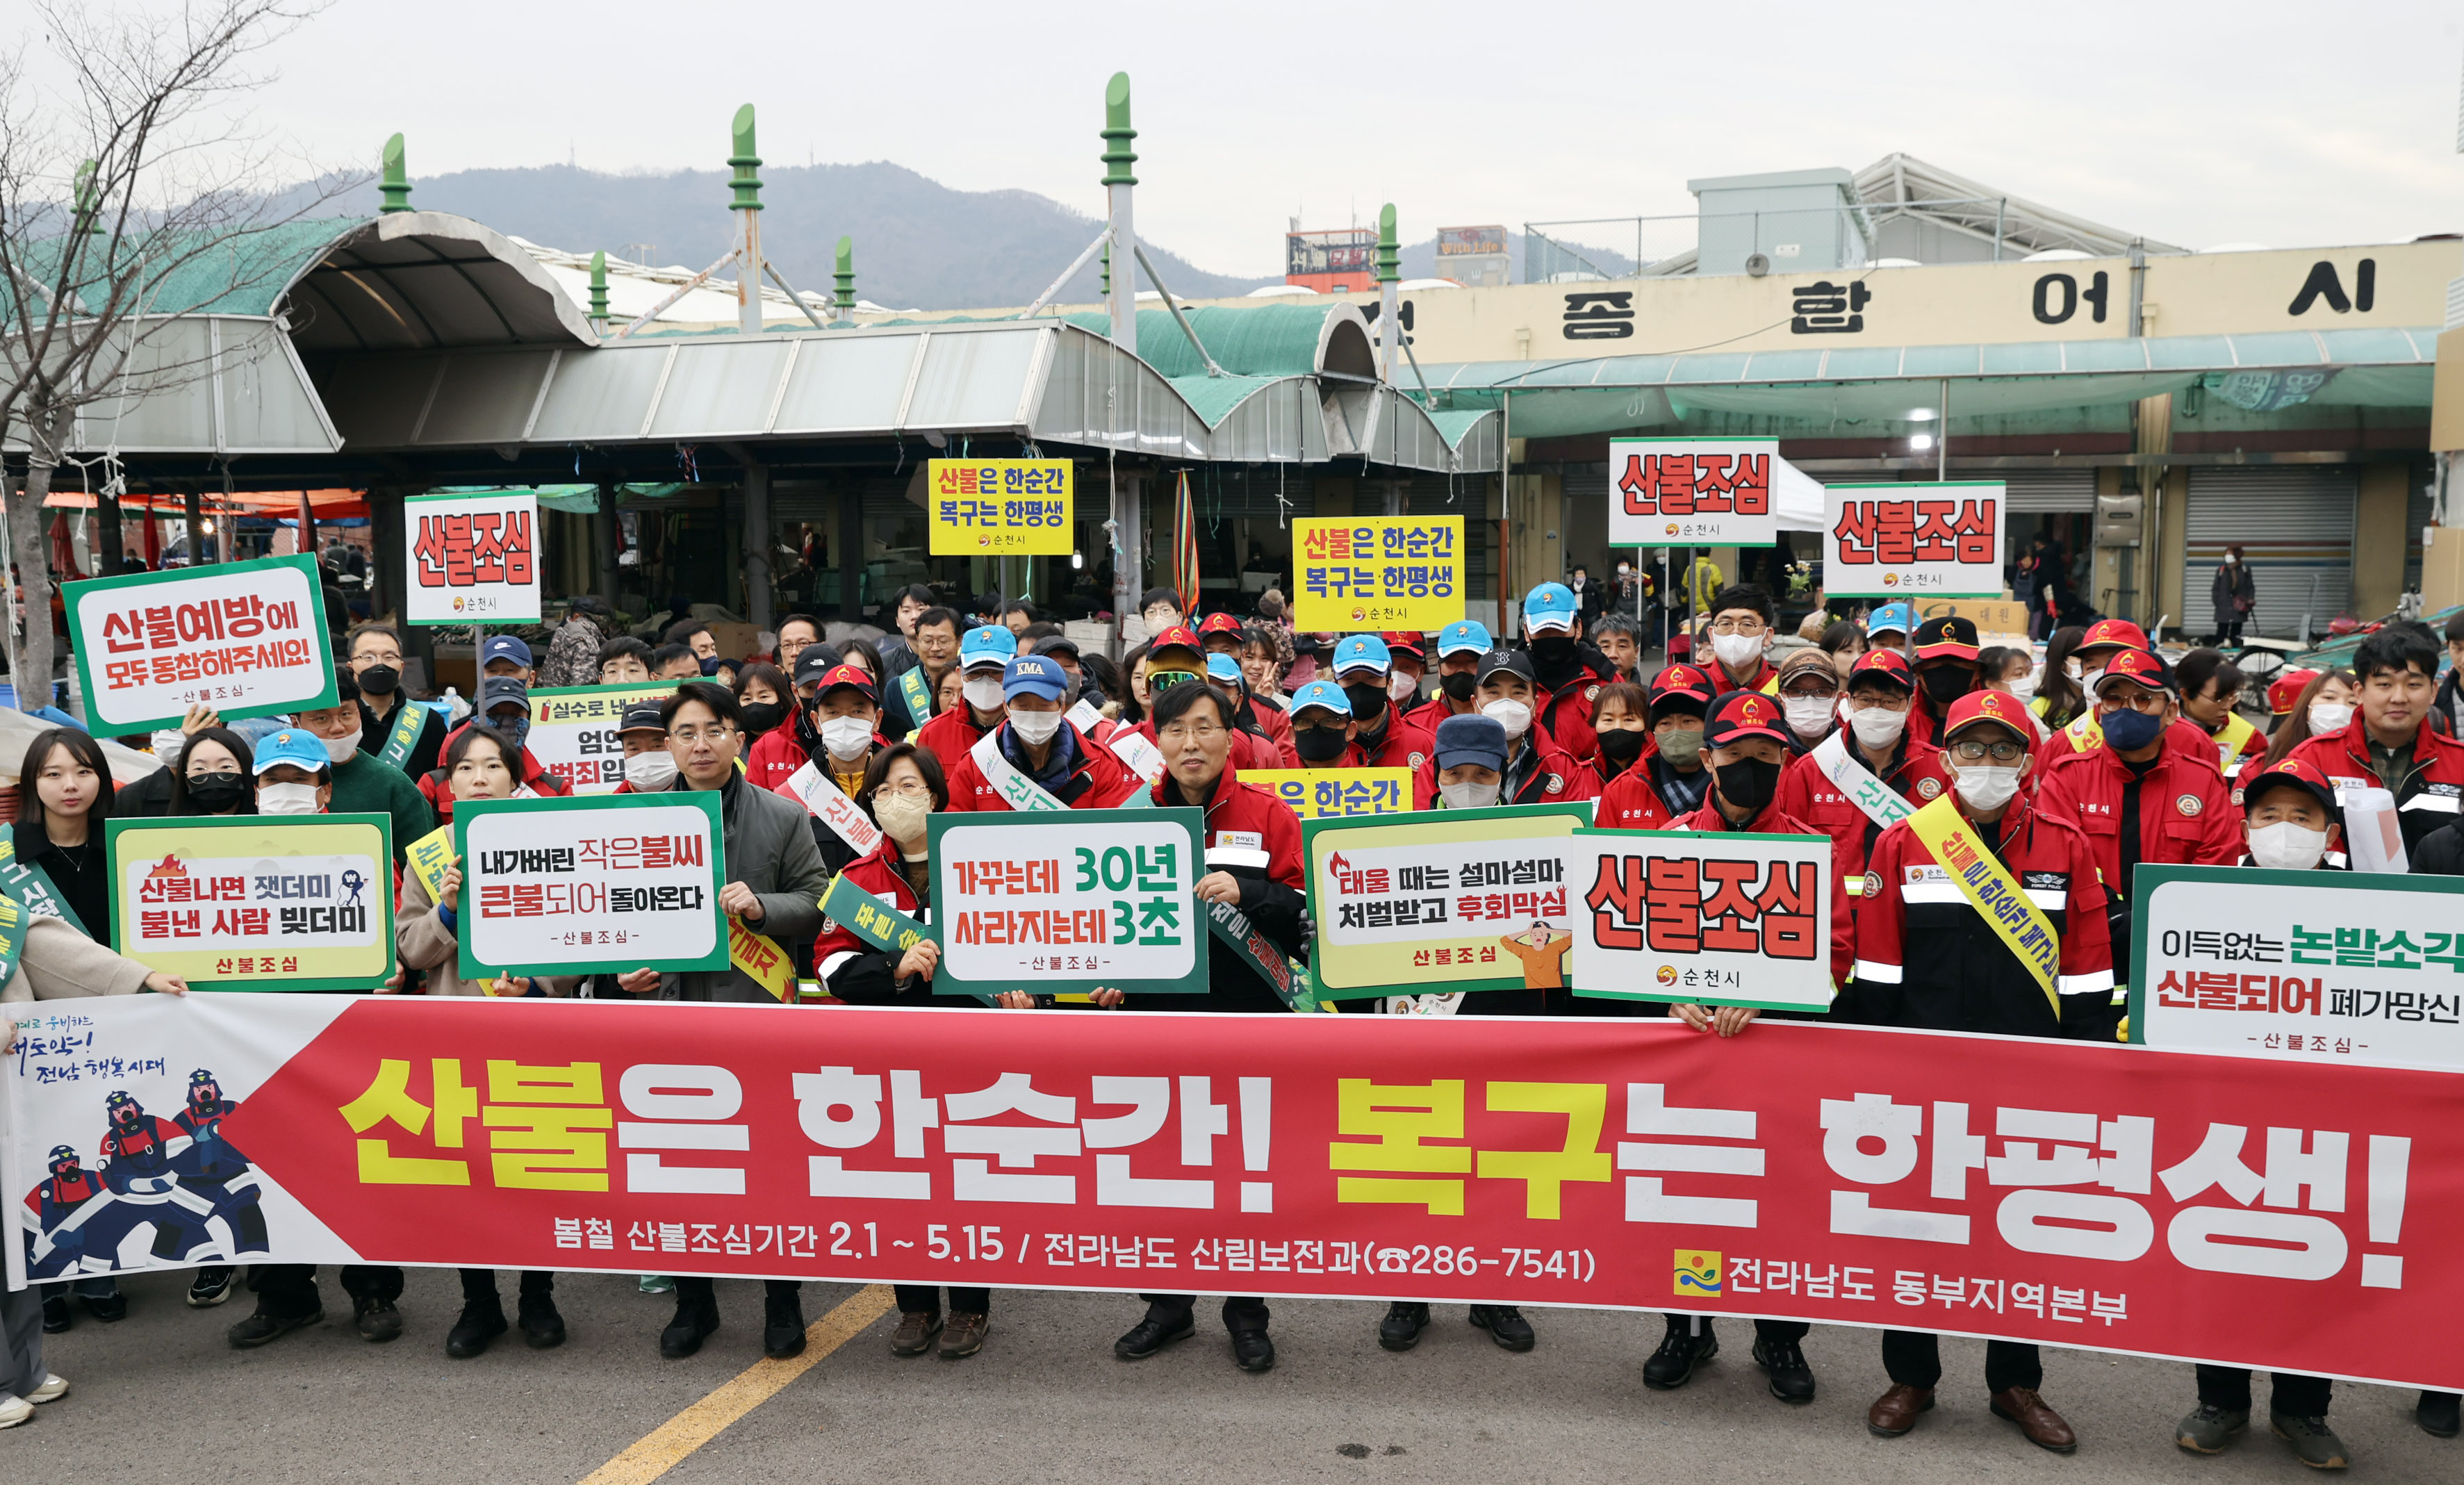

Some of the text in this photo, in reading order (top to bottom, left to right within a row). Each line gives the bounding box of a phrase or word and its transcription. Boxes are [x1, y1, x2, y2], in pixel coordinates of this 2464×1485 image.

[938, 468, 1065, 495] 산불은 한순간
[1618, 453, 1769, 516] 산불조심
[939, 499, 1065, 528] 복구는 한평생
[1683, 523, 1720, 536] 순천시
[993, 534, 1026, 545] 순천시
[1304, 527, 1454, 559] 산불은 한순간
[1834, 498, 1996, 565] 산불조심
[413, 510, 532, 587] 산불조심
[1305, 565, 1453, 598] 복구는 한평생
[1902, 573, 1942, 587] 순천시
[467, 598, 497, 612] 순천시
[1369, 607, 1408, 620] 순천시
[103, 594, 299, 654] 산불예방에
[106, 638, 311, 690] 모두 동참해주세요!
[1017, 662, 1045, 676] KMA
[552, 700, 604, 719] 실수로
[767, 762, 795, 771] 순천시
[1315, 780, 1400, 817] 한순간
[1622, 809, 1652, 819] 순천시
[1814, 793, 1846, 803] 순천시
[481, 834, 704, 875] 내가버린 작은불씨
[953, 843, 1177, 895] 가꾸는데 30년
[140, 874, 331, 903] 산불나면 잿더미
[1339, 858, 1564, 895] 태울 때는 설마설마
[479, 882, 704, 919] 큰불되어 돌아온다
[1339, 884, 1567, 928] 처벌받고 후회막심
[1586, 855, 1818, 960] 산불조심
[141, 906, 366, 939] 불낸 사람 빚더미
[955, 900, 1181, 946] 사라지는데 3초
[1413, 946, 1496, 967] 산불조심
[2162, 930, 2284, 963] 이득없는
[216, 956, 298, 974] 산불조심
[1682, 968, 1741, 988] 순천시
[2157, 969, 2460, 1024] 산불되어 폐가망신
[37, 1063, 80, 1084] 전남
[338, 1058, 2412, 1290] 산불은 한순간! 복구는 한평생!
[554, 1217, 613, 1249] 봄철
[626, 1220, 819, 1258] 산불조심기간
[830, 1221, 878, 1259] 2.1
[927, 1224, 1003, 1262] 5.15
[1044, 1233, 1176, 1270] 전라남도
[1728, 1256, 2128, 1327] 전라남도 동부지역본부
